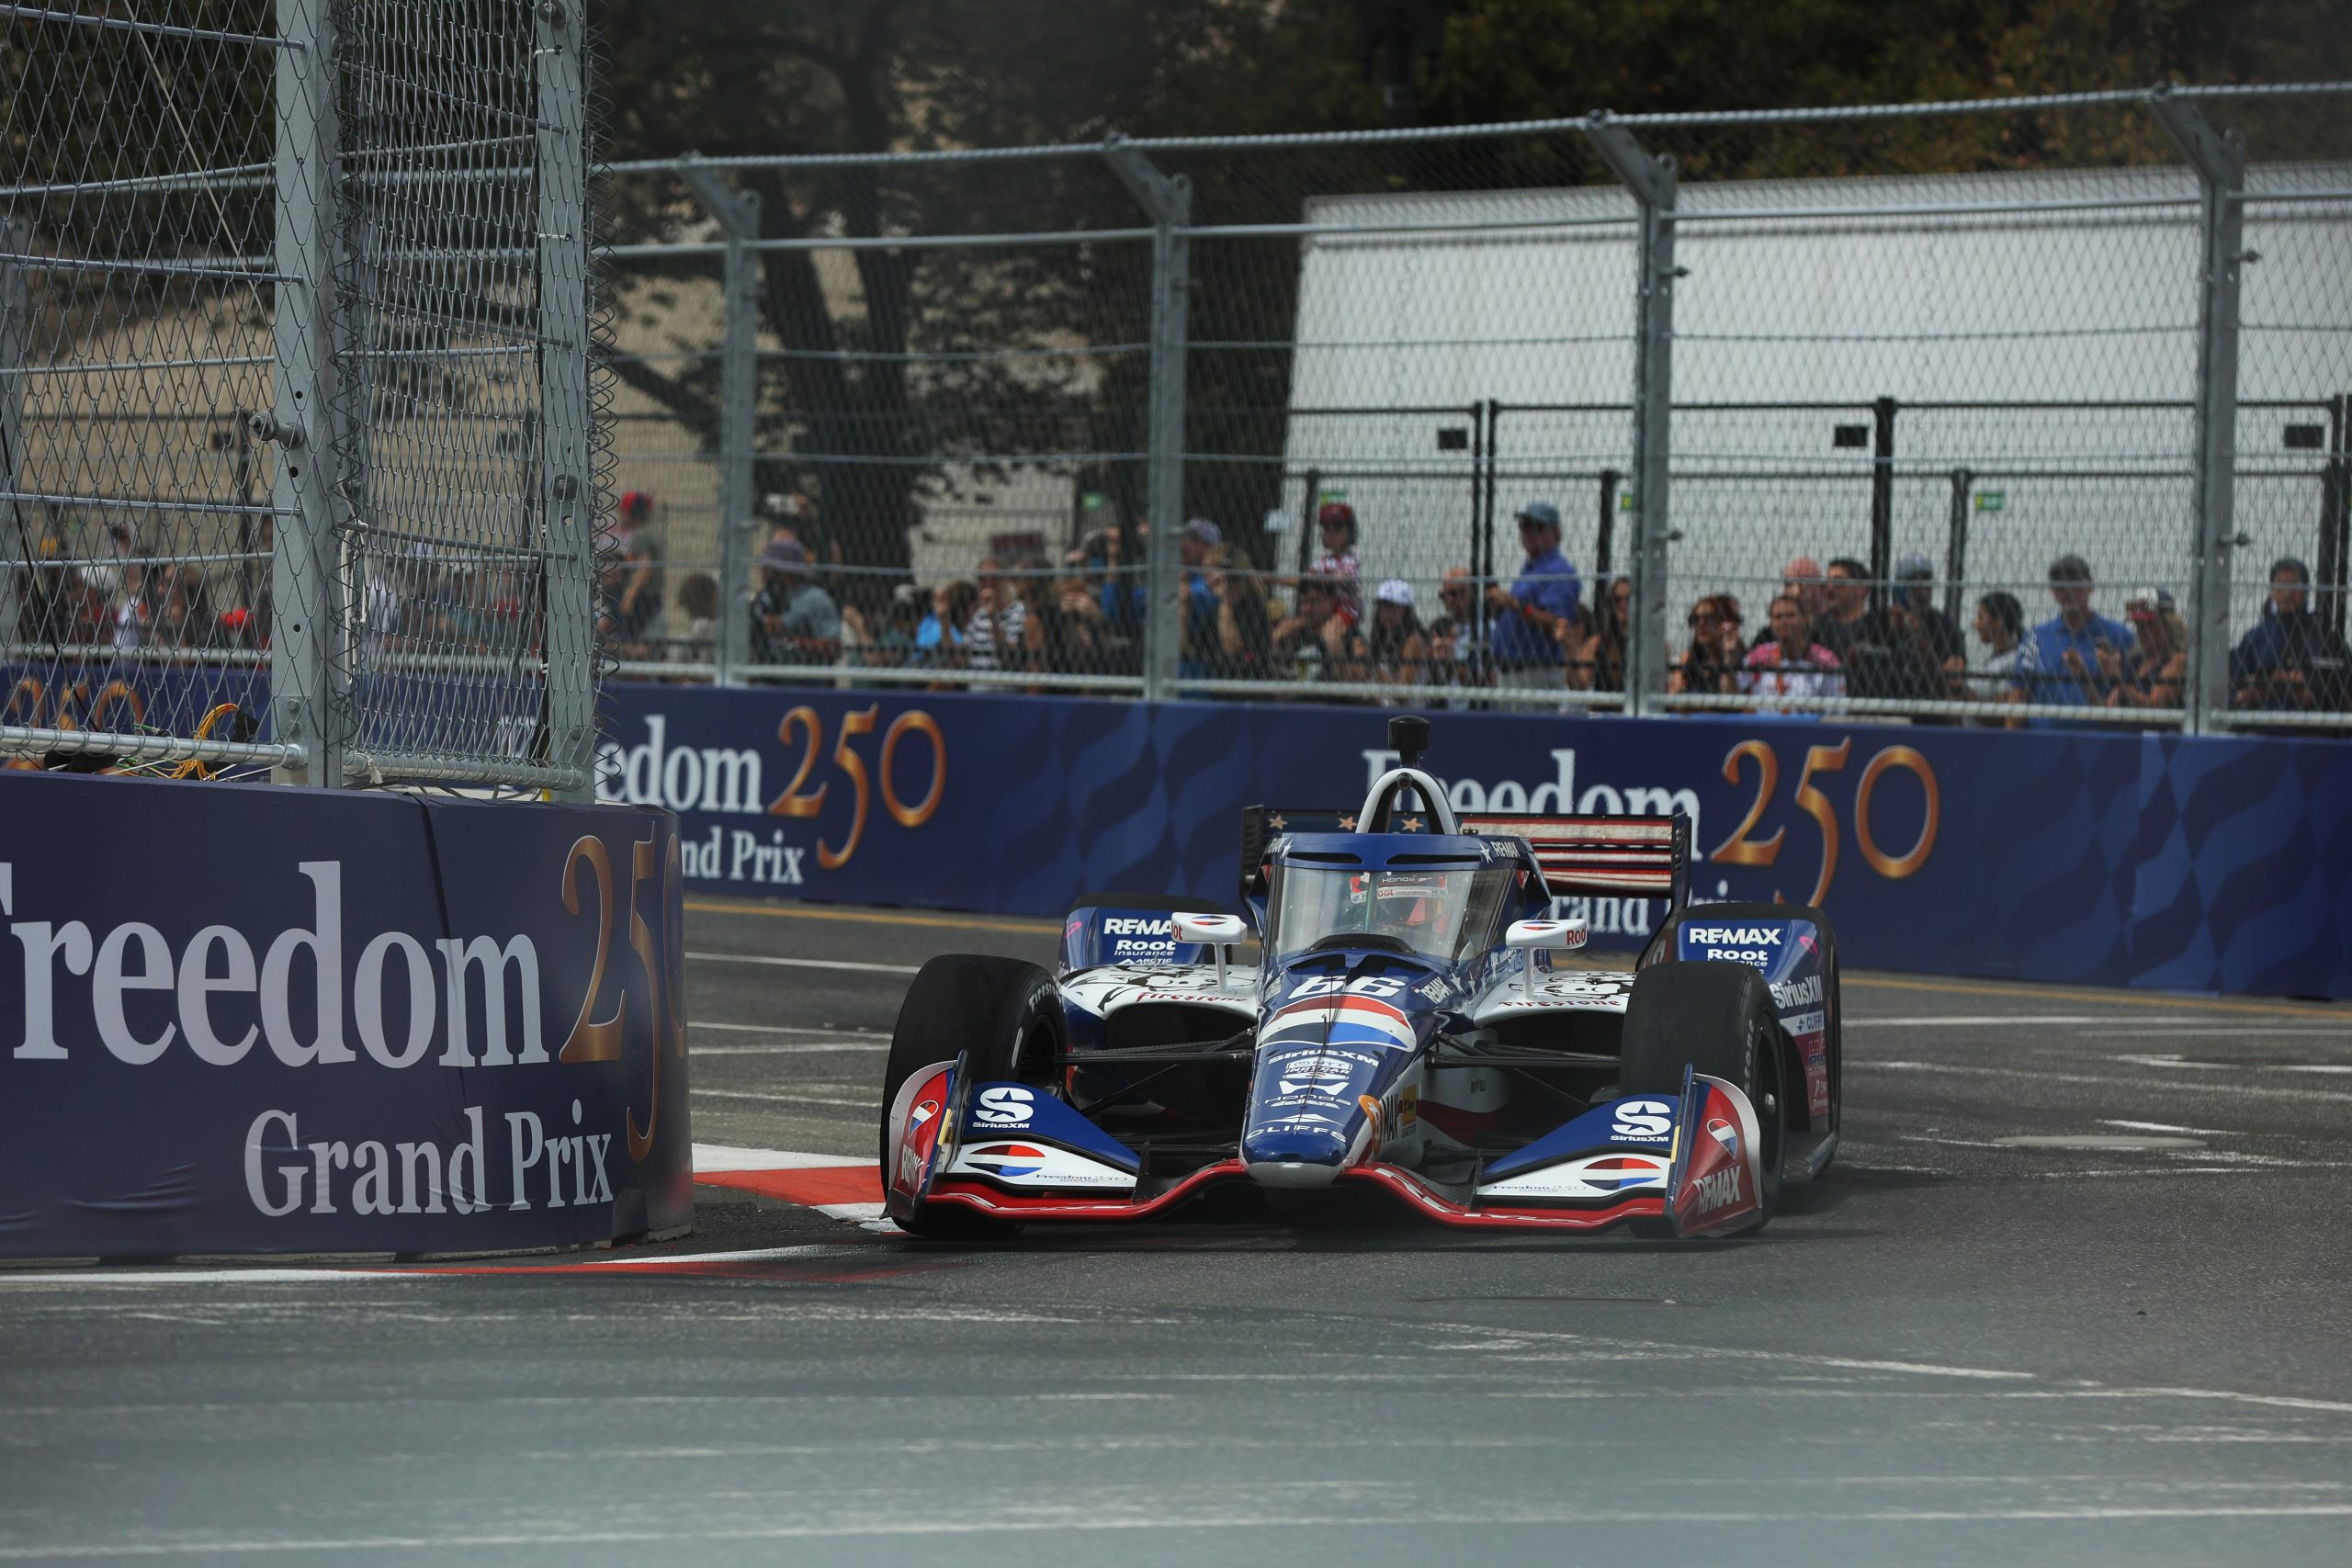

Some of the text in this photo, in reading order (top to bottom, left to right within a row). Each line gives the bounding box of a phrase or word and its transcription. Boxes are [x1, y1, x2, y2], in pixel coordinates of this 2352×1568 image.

[594, 703, 945, 868] edom 250
[1362, 735, 1939, 907] Feedom 250
[730, 829, 803, 885] Prix
[1378, 889, 1395, 897] oot
[1104, 919, 1173, 935] REMA
[1549, 897, 1650, 936] rand
[1116, 940, 1177, 951] Root
[1689, 928, 1781, 945] REMAX
[1708, 949, 1769, 961] Root
[0, 820, 687, 1162] reedom 250
[1287, 976, 1407, 998] 66
[1769, 975, 1824, 1010] SiriusXM
[1247, 1125, 1347, 1143] CLIFFS
[245, 1100, 614, 1217] Grand Prix
